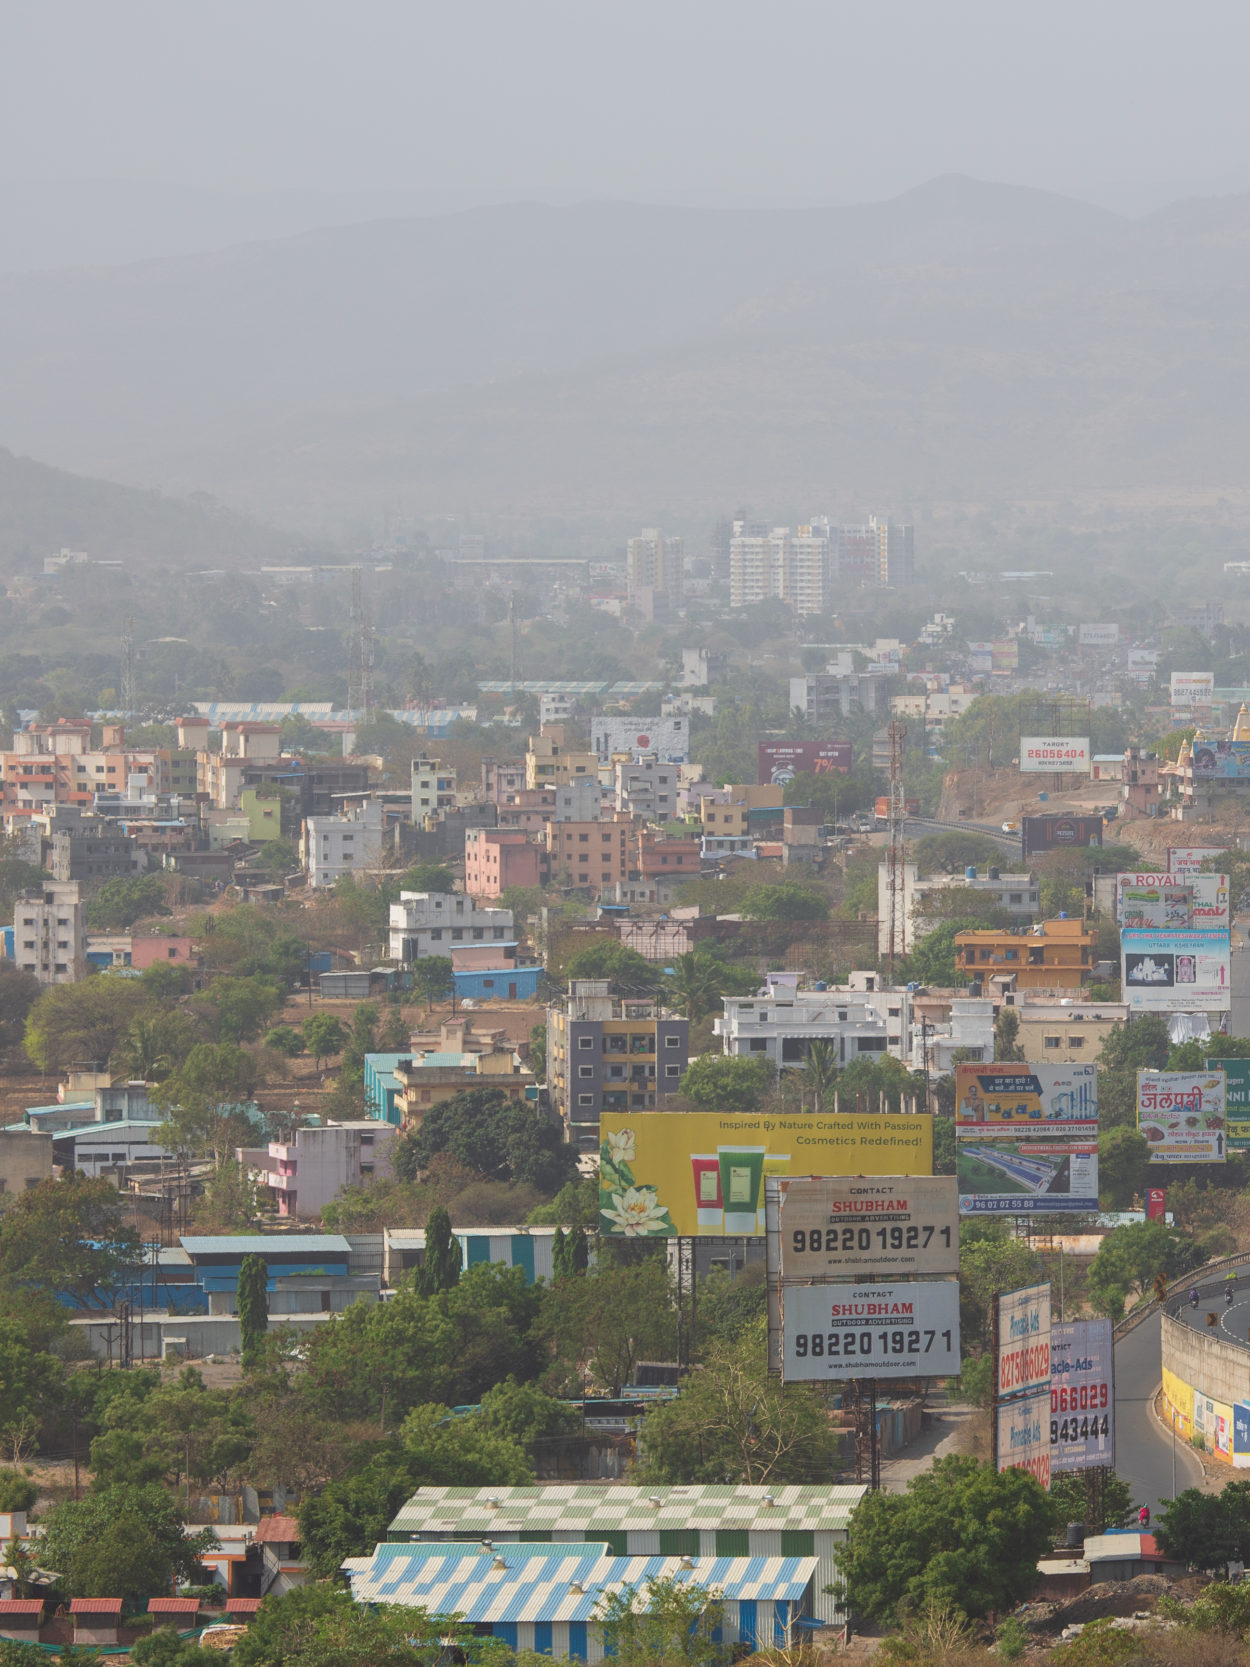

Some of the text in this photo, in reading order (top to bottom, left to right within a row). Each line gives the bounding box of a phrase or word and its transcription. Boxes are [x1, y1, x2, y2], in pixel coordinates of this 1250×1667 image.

[1027, 749, 1084, 759] 26056404
[1136, 875, 1181, 886] ROYAL
[1141, 1086, 1203, 1111] जलपरी
[719, 1120, 922, 1131] Inspired By Nature Crafted With Passion
[796, 1136, 922, 1146] Cosmetics Redefined!
[850, 1187, 895, 1195] CONTACT
[832, 1200, 908, 1212] SHUBHAM
[832, 1303, 913, 1316] SHUBHAM
[832, 1317, 913, 1327] OUTDOOR ADVERTISING
[1051, 1344, 1071, 1352] NTACT
[1001, 1342, 1050, 1390] 8275066029
[1051, 1358, 1093, 1374] acle-Ads
[1051, 1383, 1108, 1413] 066029
[1051, 1414, 1109, 1444] 943444
